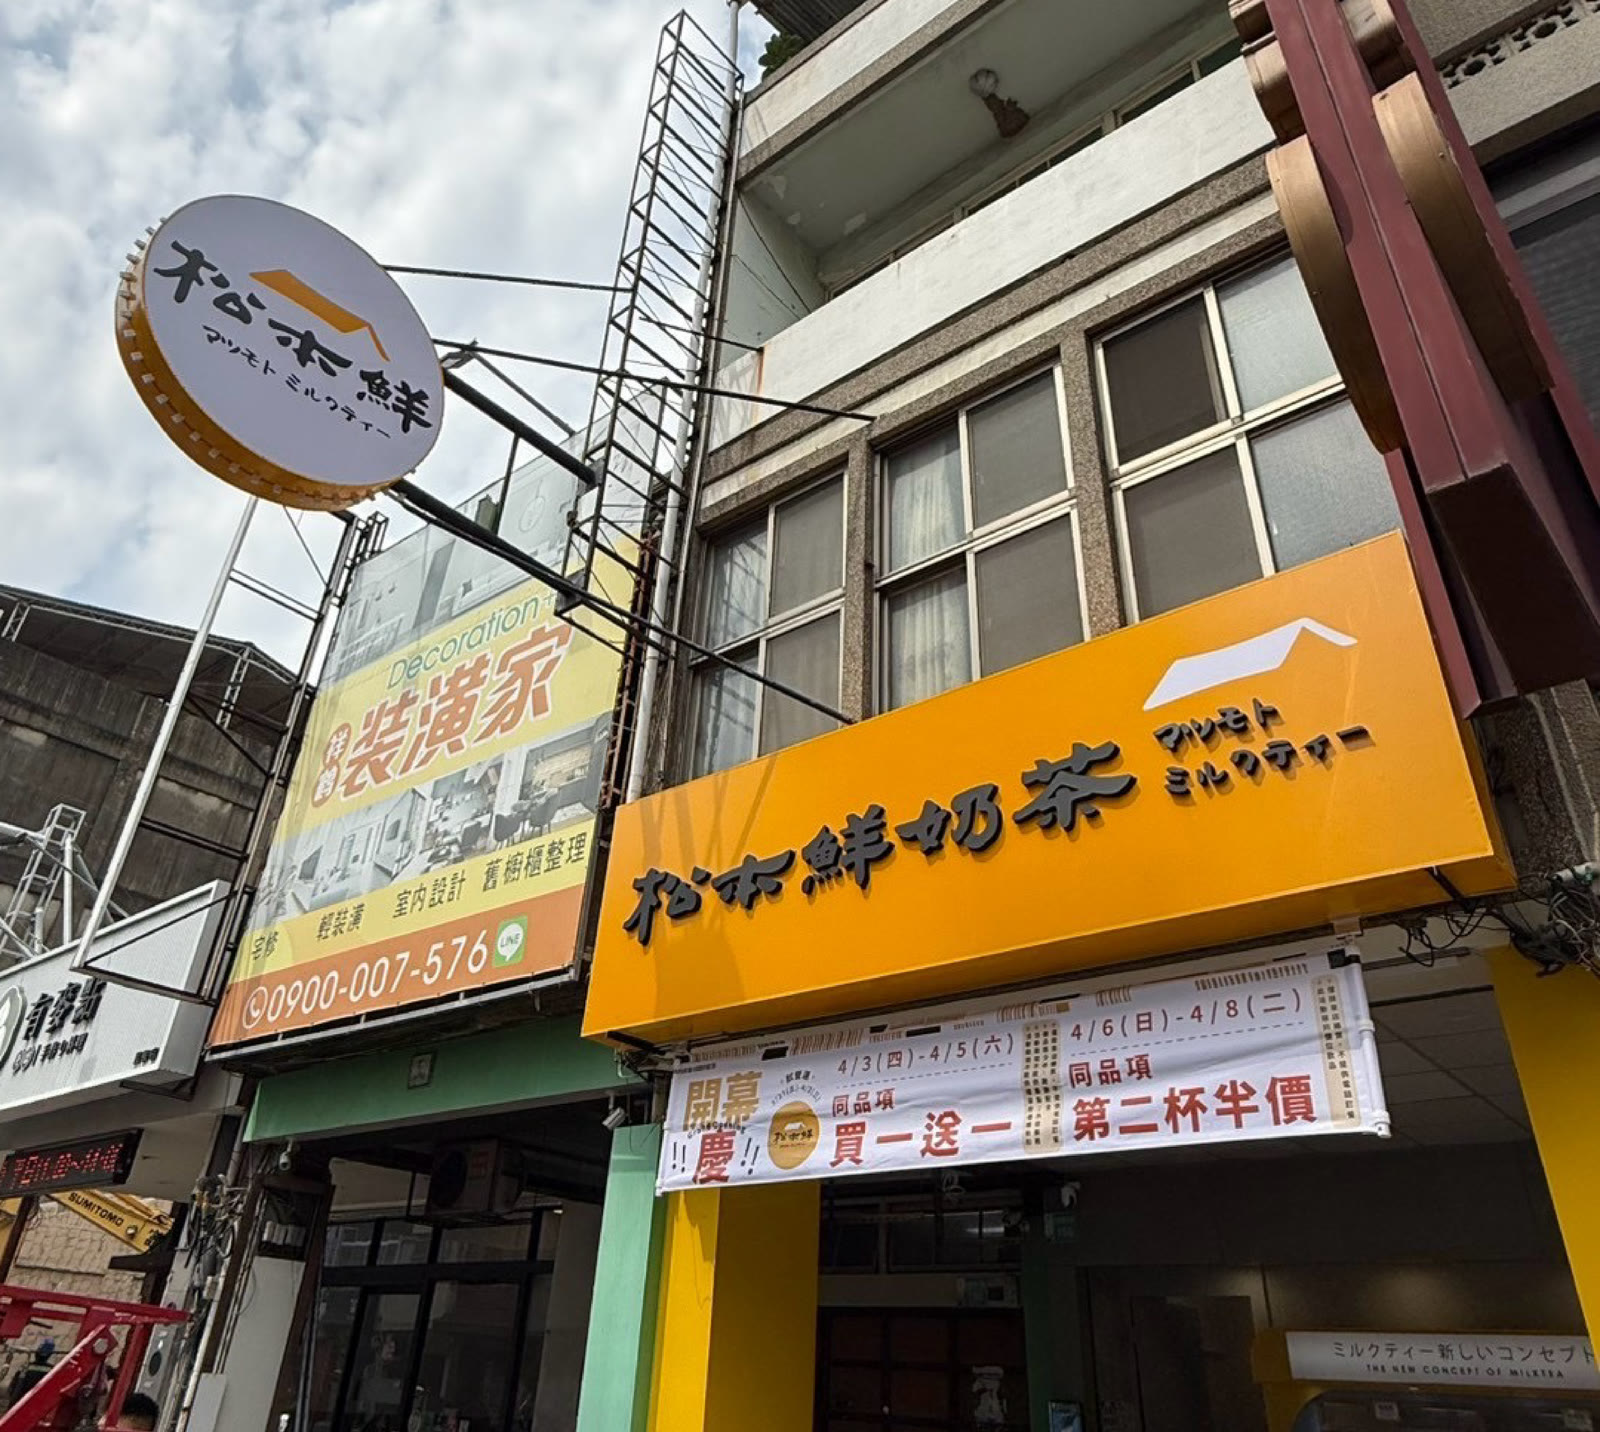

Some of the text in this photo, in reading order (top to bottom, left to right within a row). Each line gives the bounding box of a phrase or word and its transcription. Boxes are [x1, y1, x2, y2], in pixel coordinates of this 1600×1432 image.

[153, 240, 433, 433] 松本鮮
[202, 324, 391, 438] マツモト ミルクティー
[342, 624, 574, 798] 裝潢家
[1154, 696, 1281, 754] マツモト
[1163, 724, 1374, 798] ミルクティー
[623, 740, 1138, 947] 松本鮮奶茶
[266, 930, 522, 1023] 0900-007-576 LINE
[1070, 988, 1302, 1043] 4/6(日)-4/8(二)
[836, 1033, 1015, 1076] 4/3(四)-4/5(六)
[1068, 1054, 1153, 1089] 同品項
[683, 1070, 763, 1131] 開幕
[831, 1088, 896, 1118] 同品項
[1072, 1074, 1319, 1142] 第二杯半價
[829, 1111, 1013, 1168] 買一送一
[67, 1191, 125, 1227] SUMITOMO
[1366, 1363, 1387, 1374] THE
[1392, 1364, 1416, 1375] NEW
